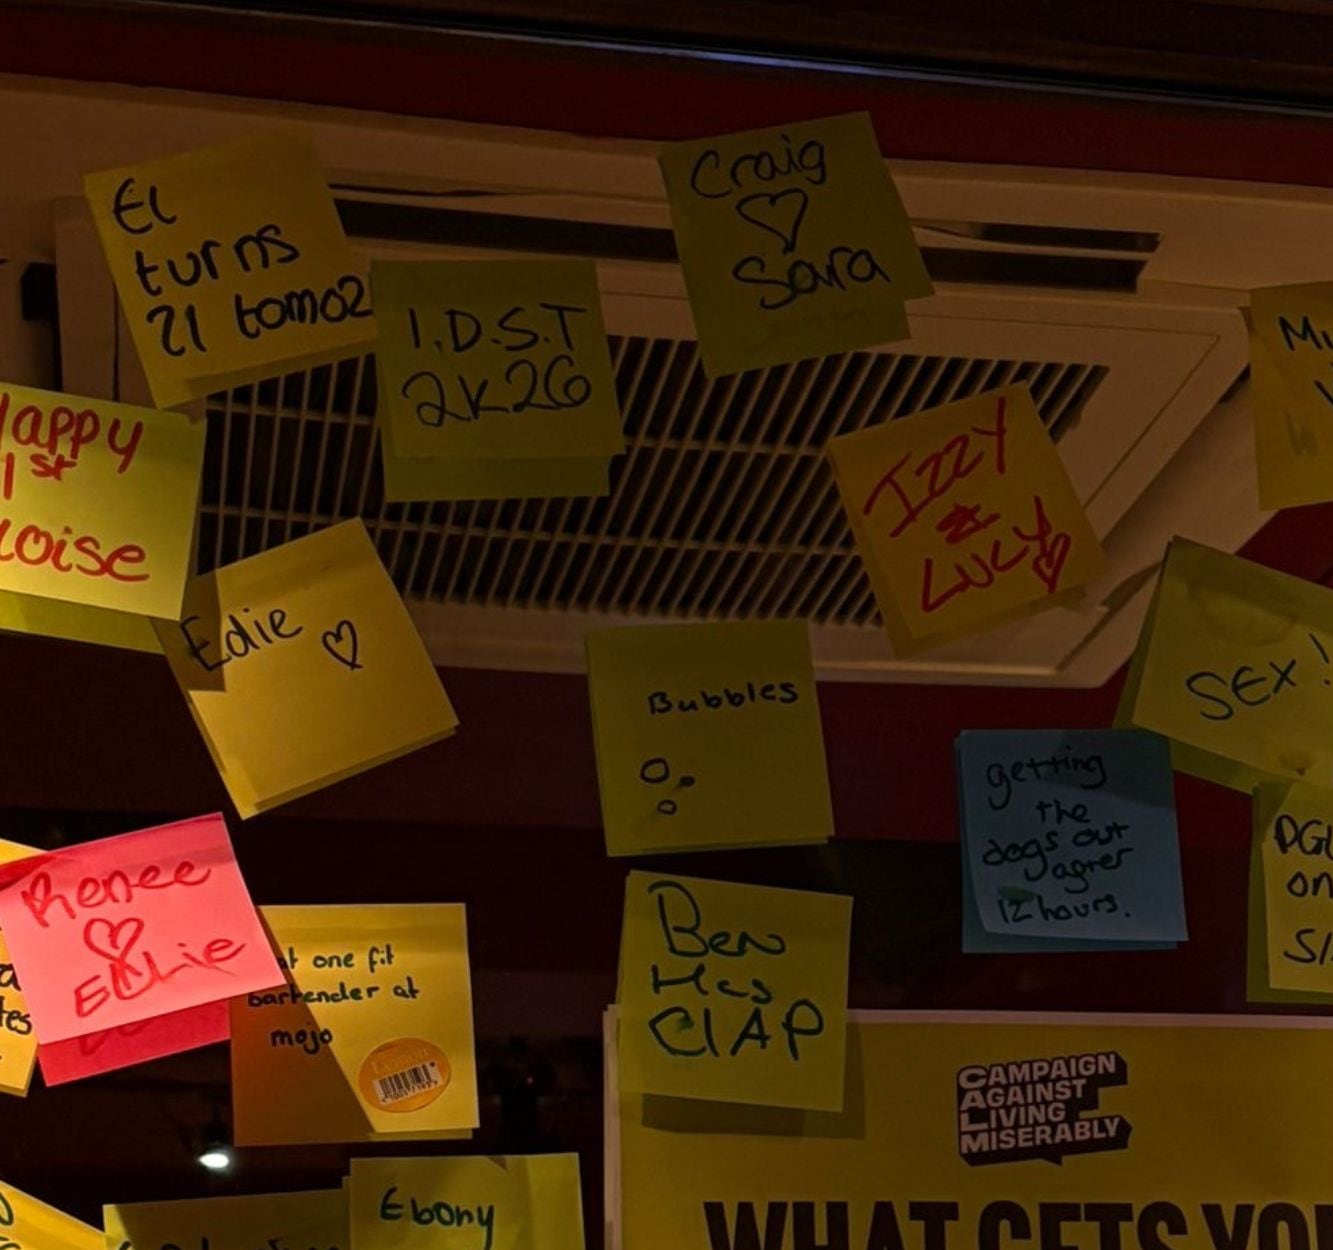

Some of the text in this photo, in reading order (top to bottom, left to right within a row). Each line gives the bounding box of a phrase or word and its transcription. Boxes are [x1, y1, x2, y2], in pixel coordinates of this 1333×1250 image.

[691, 135, 827, 198] Craig
[135, 223, 300, 297] turns
[732, 247, 890, 310] Sara
[179, 606, 304, 673] Edie
[647, 680, 799, 715] Bubbles
[985, 745, 1107, 811] getting
[1036, 799, 1090, 825] the
[982, 822, 1130, 882] dogs out
[20, 860, 212, 929] Renee
[648, 880, 787, 958] Ben
[313, 944, 396, 972] one fit
[247, 975, 421, 1007] bartender at
[271, 1027, 334, 1058] mojo
[957, 1052, 1118, 1090] CAMPAIGN
[959, 1078, 1087, 1110] AGAINST
[959, 1104, 1067, 1131] LIVING
[959, 1116, 1122, 1154] MISERABLY
